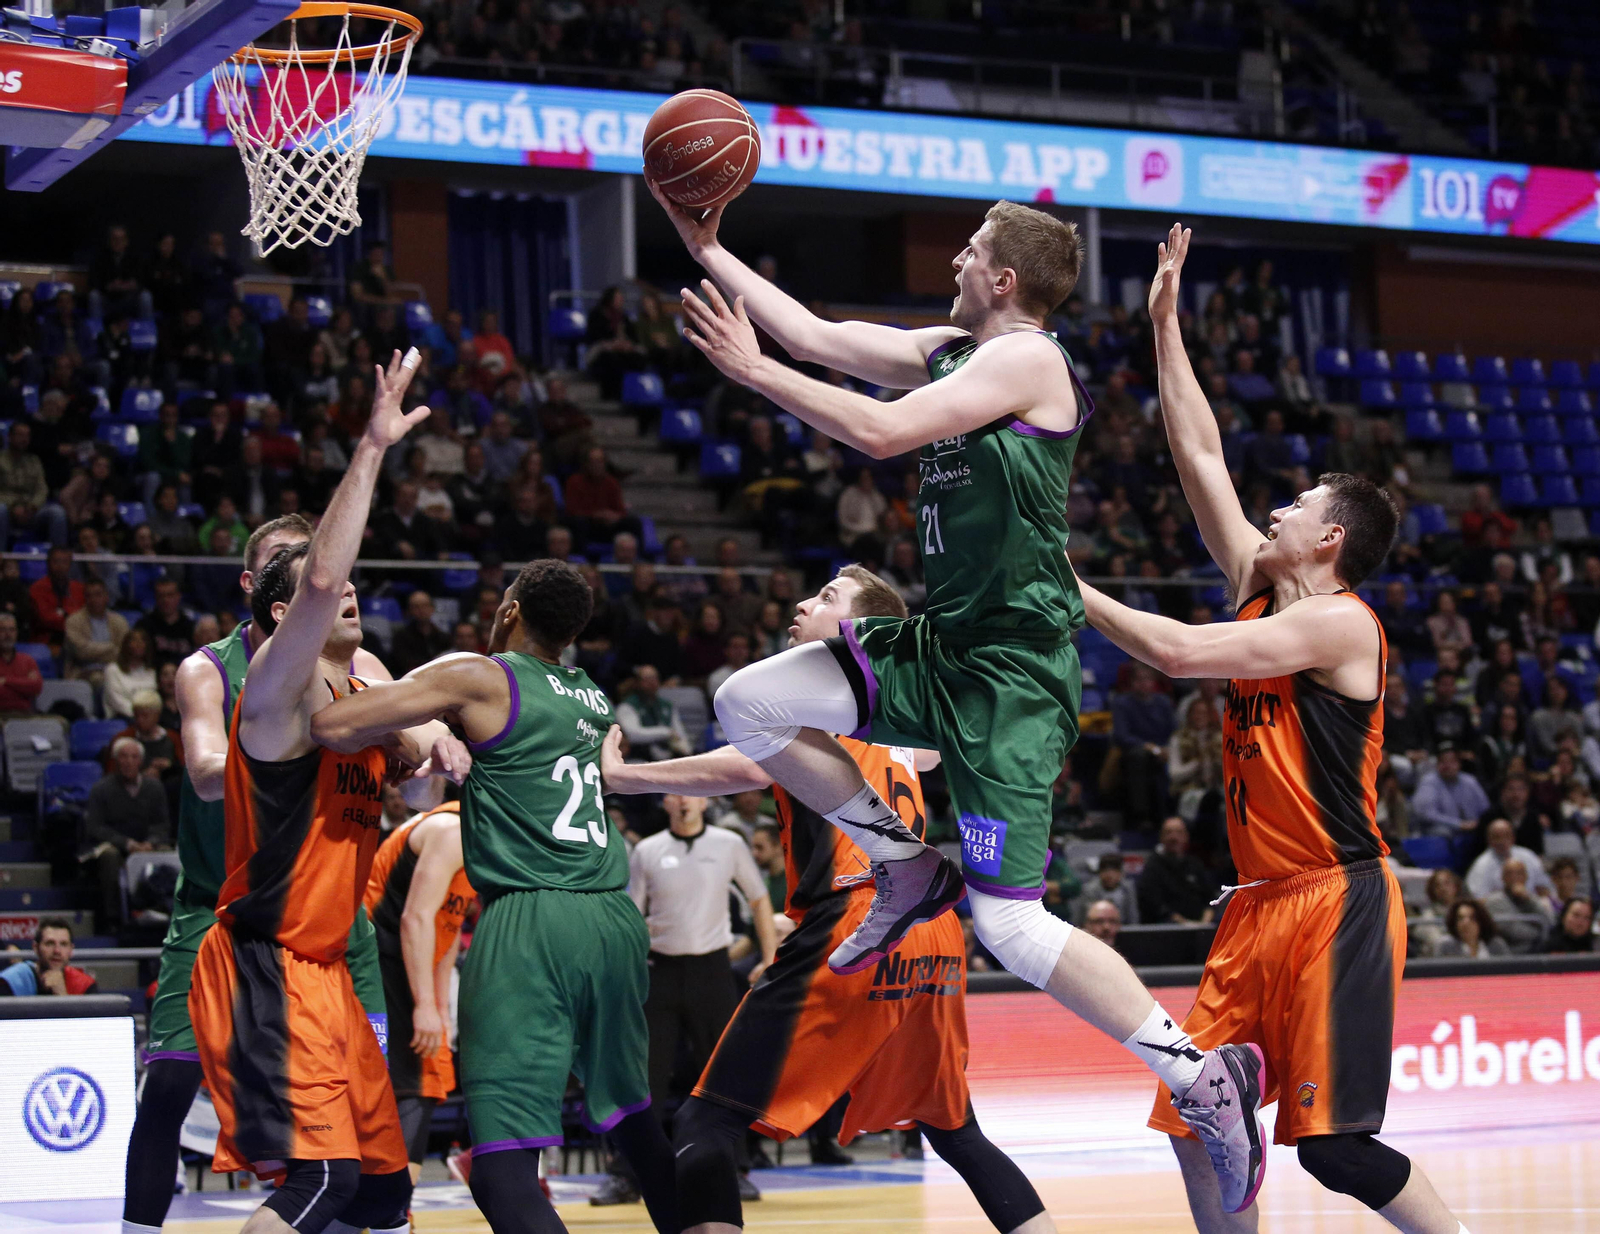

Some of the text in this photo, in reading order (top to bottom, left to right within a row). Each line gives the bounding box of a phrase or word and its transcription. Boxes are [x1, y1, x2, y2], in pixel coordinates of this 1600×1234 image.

[0, 70, 23, 93] s
[1000, 142, 1109, 190] APP
[1419, 168, 1485, 222] 101
[921, 503, 945, 555] 21
[551, 755, 608, 848] 23
[964, 826, 998, 847] má
